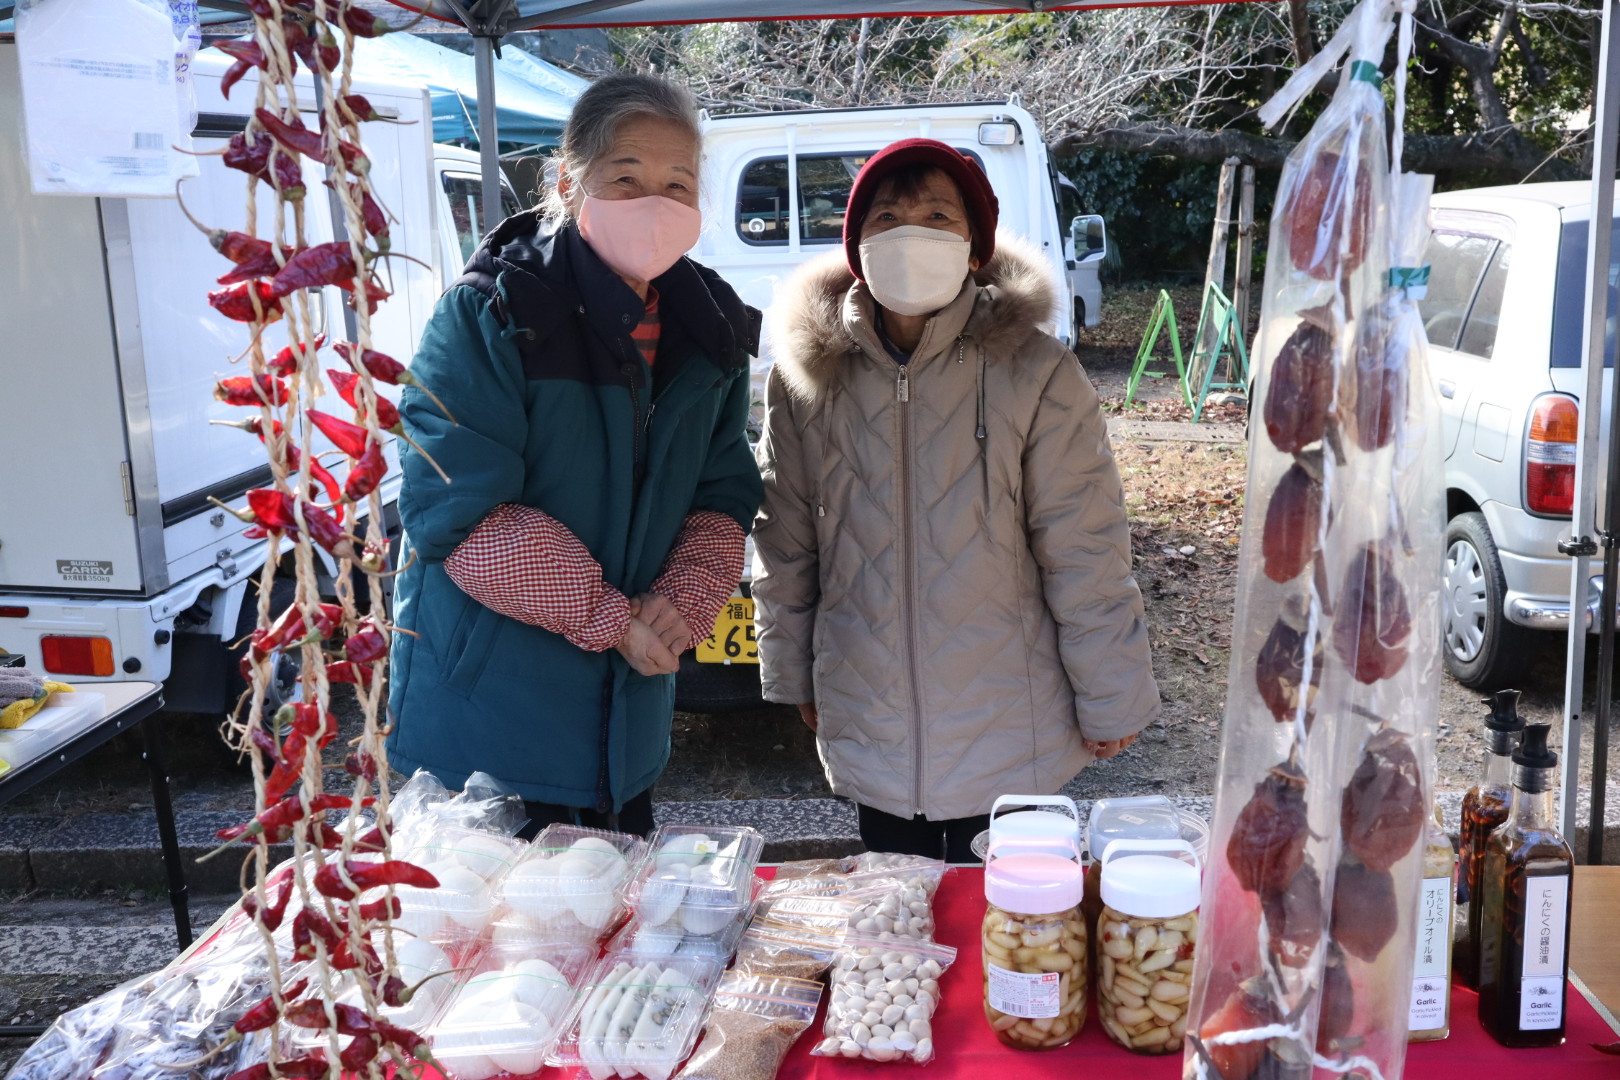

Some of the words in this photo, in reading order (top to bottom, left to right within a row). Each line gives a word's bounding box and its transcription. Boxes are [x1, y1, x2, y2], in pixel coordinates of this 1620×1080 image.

[60, 565, 110, 575] CARRY
[1435, 888, 1445, 924] にんにくの
[1422, 889, 1436, 964] オリーブオイル漬
